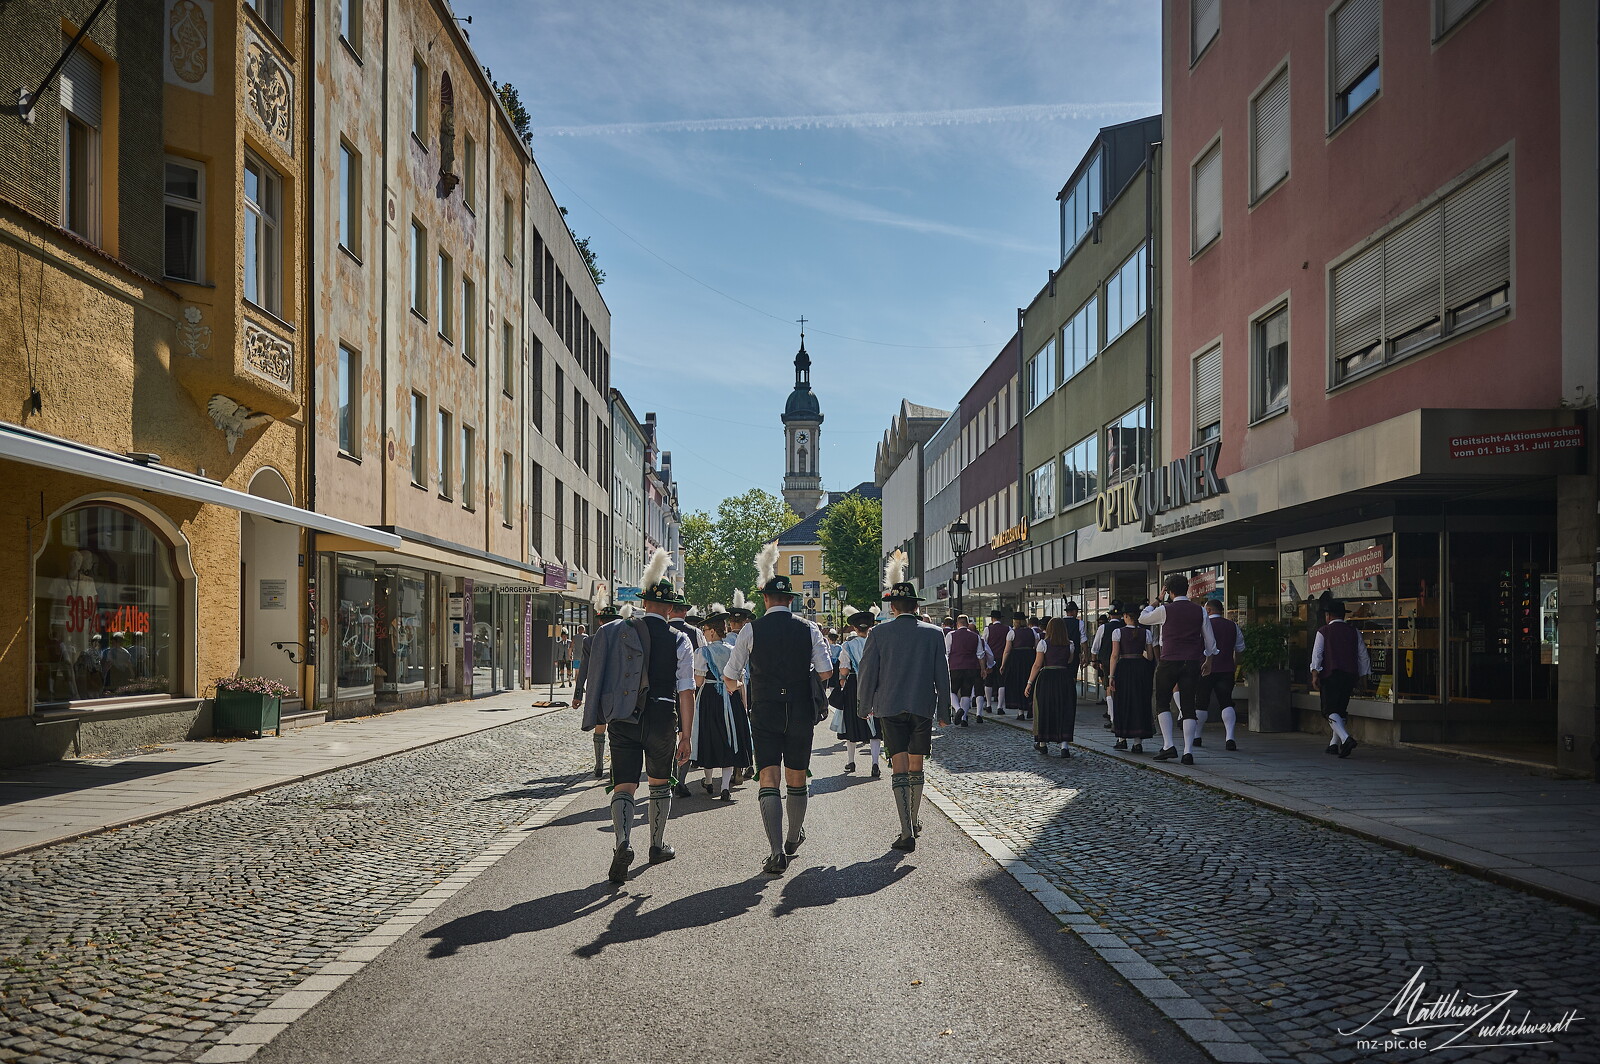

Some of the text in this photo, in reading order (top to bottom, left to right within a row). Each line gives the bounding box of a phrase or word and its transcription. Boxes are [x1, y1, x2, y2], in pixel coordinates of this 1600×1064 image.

[1452, 429, 1580, 446] Gleitsicht-Aktionswochen
[1454, 438, 1581, 457] vom 01. bis 31. Juli 2025!
[1096, 442, 1223, 533] OPTIK JULINEK
[1309, 550, 1382, 578] Gleitsicht-Aktionswochen
[1310, 562, 1382, 591] vom 01. bis 31. Juli 2025!
[499, 584, 540, 593] HÖRGERÄTE
[105, 604, 123, 633] auf
[124, 604, 150, 633] Alles
